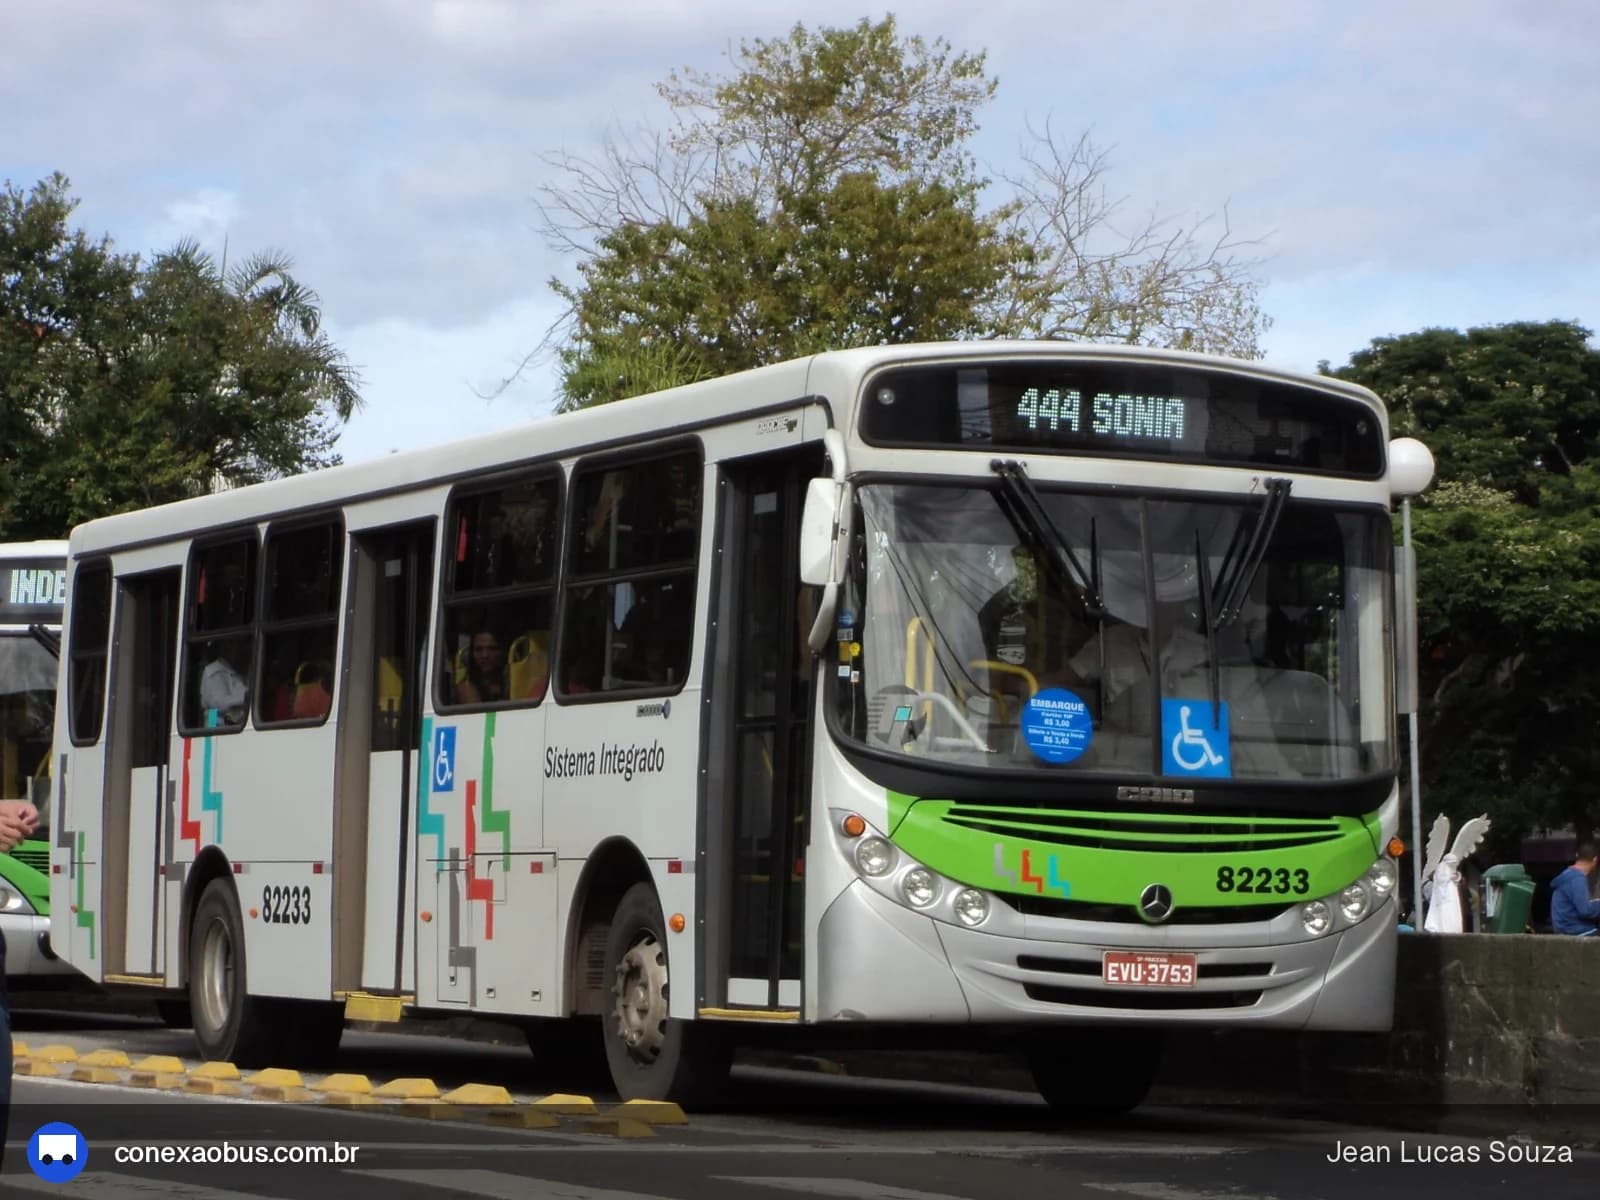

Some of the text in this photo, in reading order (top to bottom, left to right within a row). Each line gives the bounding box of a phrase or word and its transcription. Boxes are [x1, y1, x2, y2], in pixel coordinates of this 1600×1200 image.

[1017, 387, 1184, 439] 444 SONIA
[1030, 698, 1085, 712] EMBARQUE
[544, 738, 665, 782] Sistema Integrado
[1215, 866, 1310, 894] 82233
[262, 884, 311, 925] 82233
